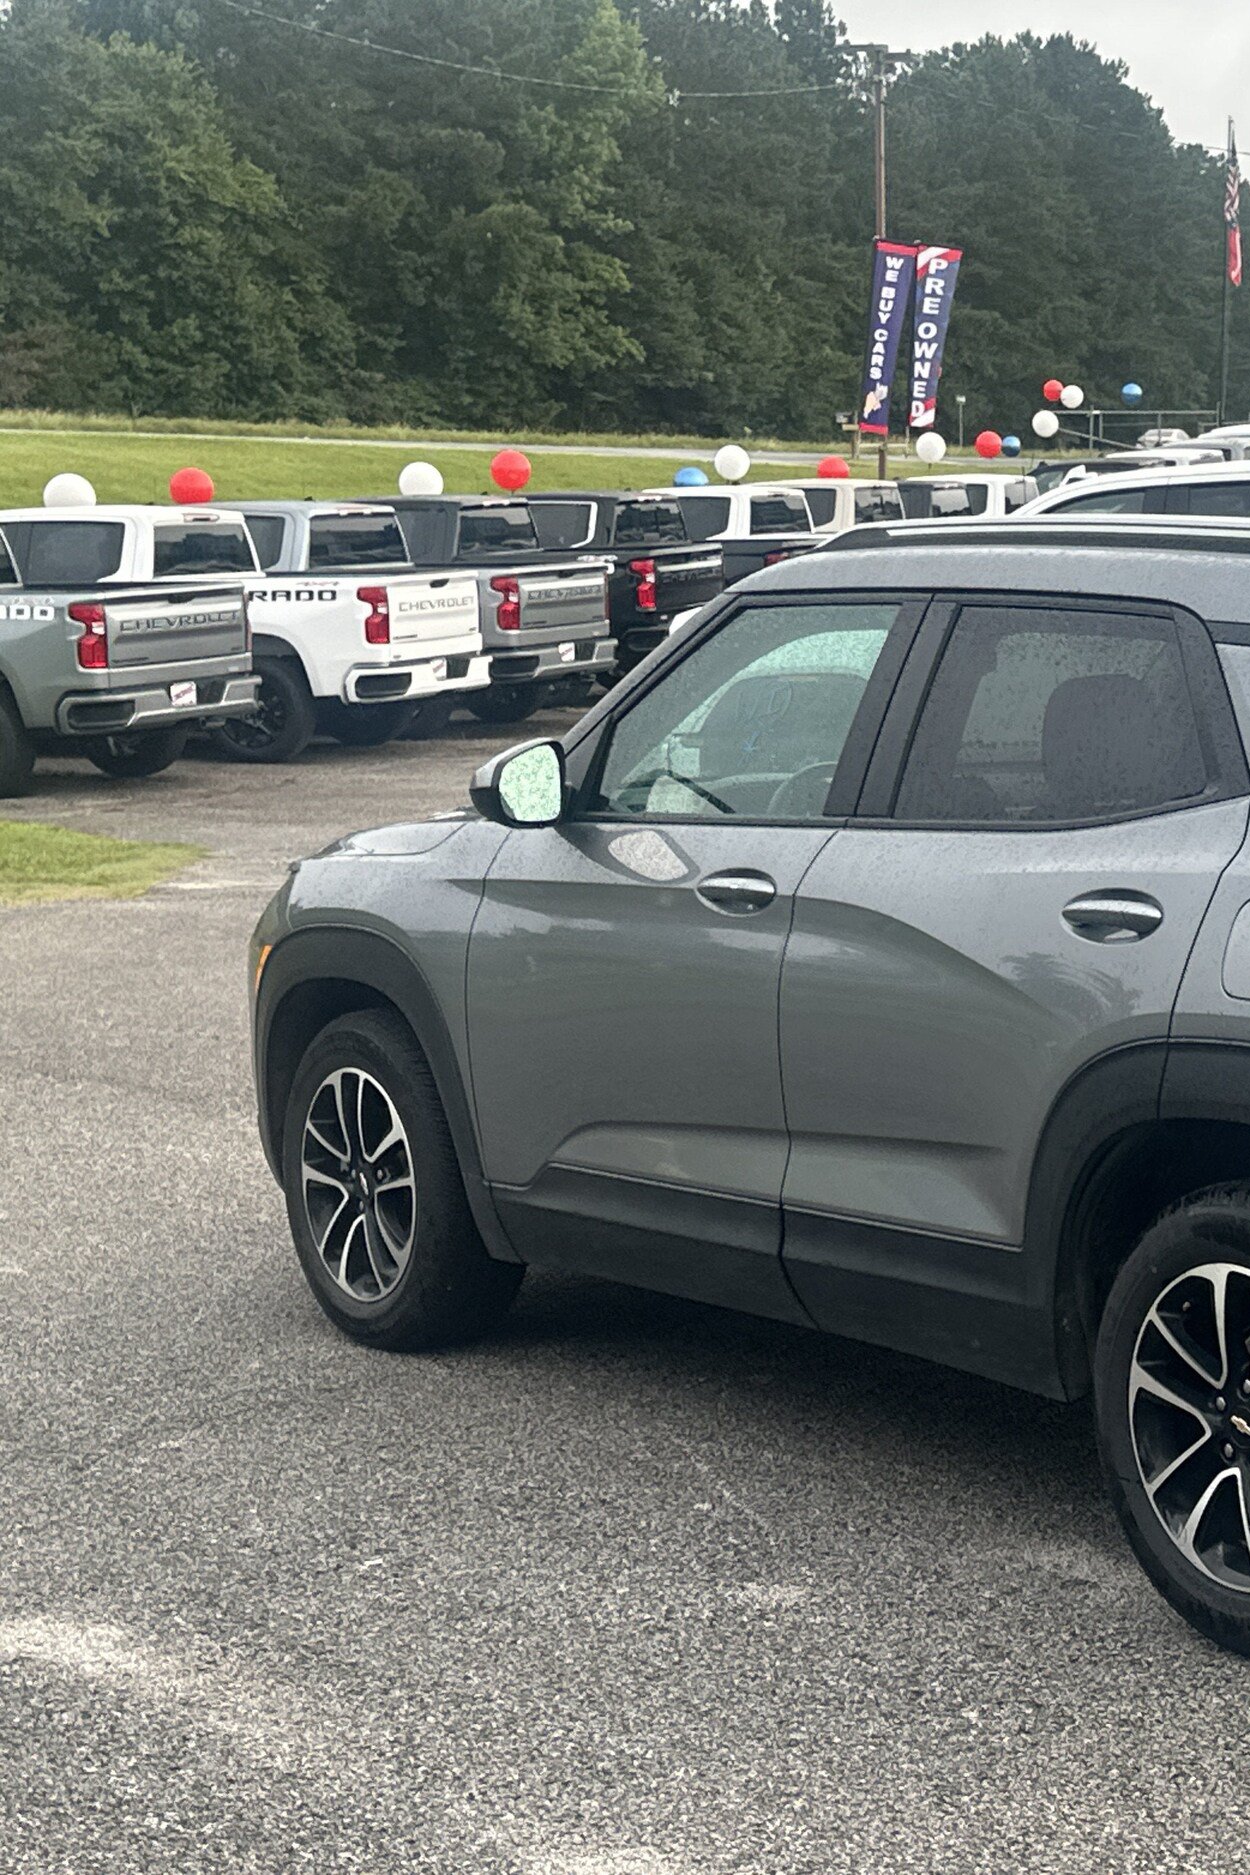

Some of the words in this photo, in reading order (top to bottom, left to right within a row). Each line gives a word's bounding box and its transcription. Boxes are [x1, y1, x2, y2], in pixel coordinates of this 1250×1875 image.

[885, 256, 904, 282] WE
[922, 258, 949, 315] PRE
[879, 287, 896, 324] BUY
[870, 328, 888, 380] CARS
[911, 322, 938, 417] OWNED
[248, 589, 337, 602] RADO
[398, 595, 475, 612] CHEVROLET
[120, 611, 237, 631] CHEVROLET
